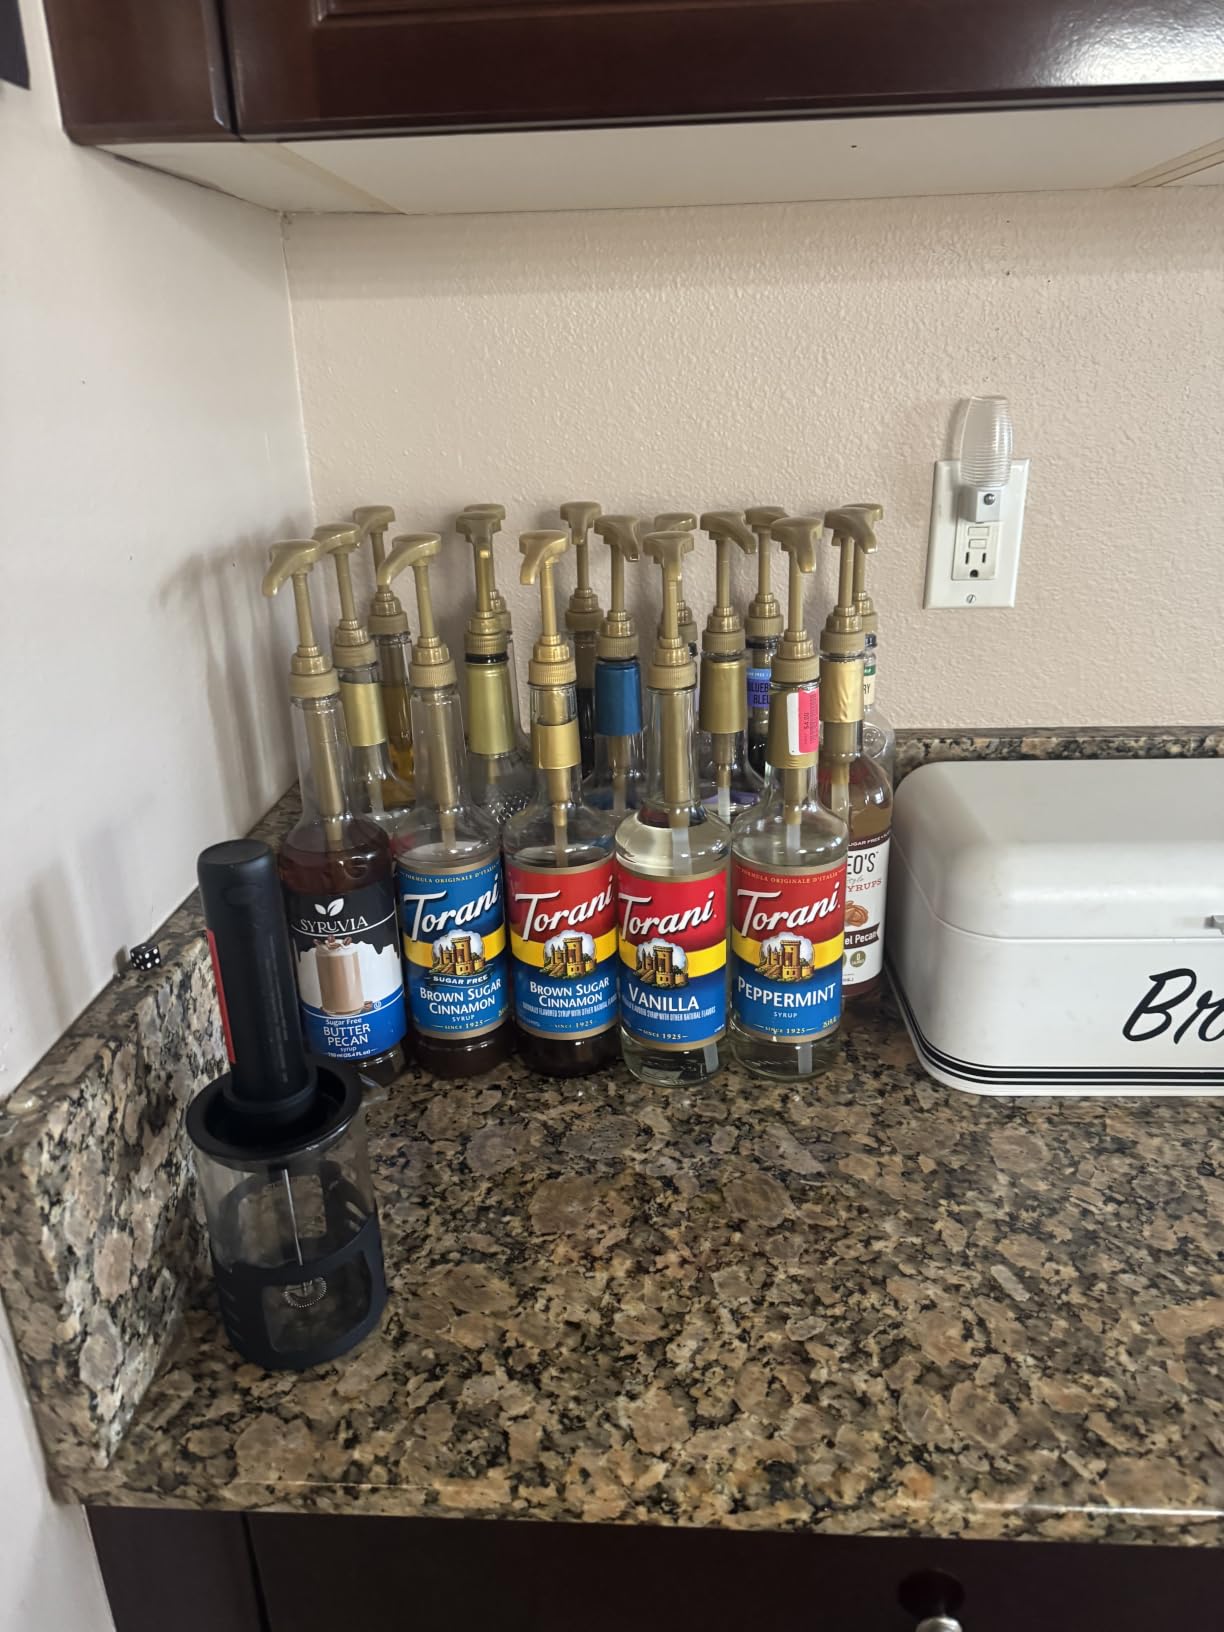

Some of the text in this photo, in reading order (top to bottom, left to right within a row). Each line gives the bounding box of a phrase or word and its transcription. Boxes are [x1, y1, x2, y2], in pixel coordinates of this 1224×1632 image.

[848, 852, 877, 875] EO'S
[435, 874, 472, 884] ORIGINALE
[848, 879, 882, 893] YRUPS
[403, 874, 498, 942] Torani
[514, 875, 613, 942] Torani
[618, 890, 715, 940] Torani
[737, 882, 840, 937] Torani
[300, 916, 369, 934] SYRUVIA
[854, 931, 877, 943] Pecan
[432, 975, 488, 985] SUGAR FREE
[530, 977, 610, 996] BROWN SUGAR
[420, 978, 502, 1002] BROWN SUGAR
[628, 983, 700, 1012] VANILLA
[738, 976, 836, 1008] PEPPERMINT
[429, 995, 496, 1015] CINNAMON
[538, 992, 603, 1008] CINNAMON
[452, 1014, 474, 1022] SYRUP
[670, 1014, 684, 1022] OTHER
[684, 1012, 701, 1020] NATURAL
[774, 1010, 798, 1018] SYRUP
[323, 1024, 371, 1036] BUTTER
[465, 1020, 484, 1028] 1925
[576, 1020, 593, 1028] 1925
[328, 1034, 368, 1046] PECAN
